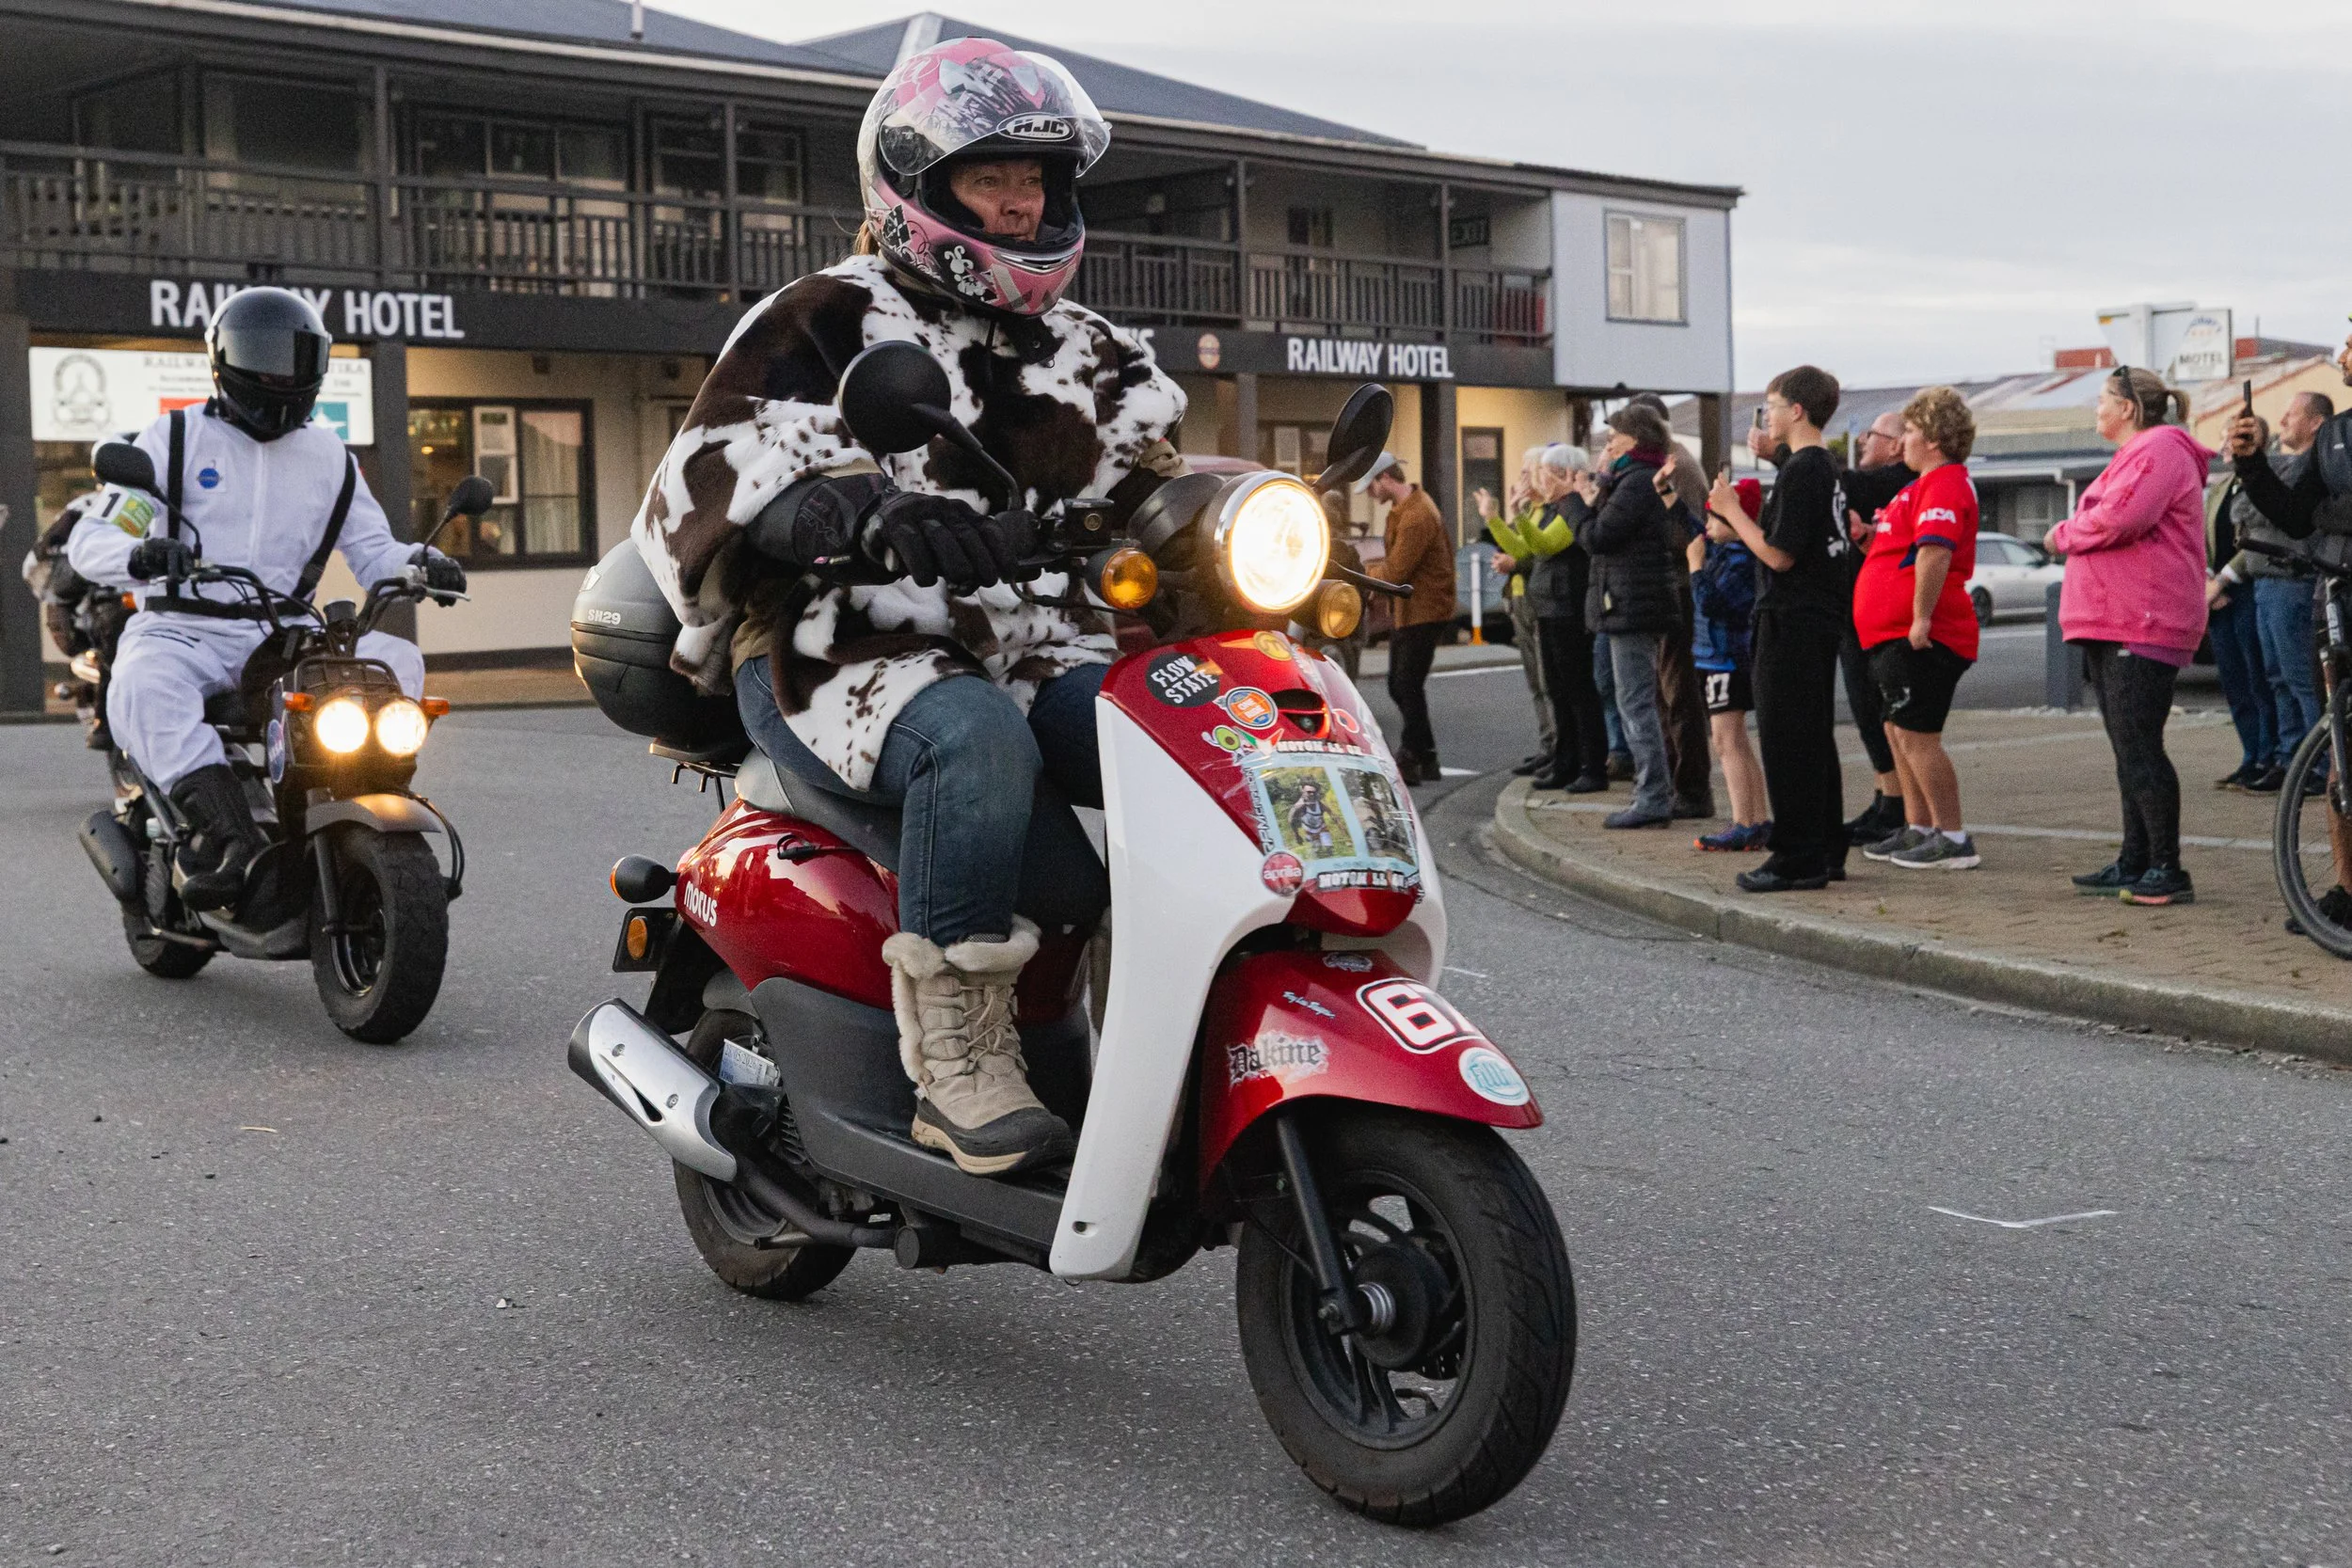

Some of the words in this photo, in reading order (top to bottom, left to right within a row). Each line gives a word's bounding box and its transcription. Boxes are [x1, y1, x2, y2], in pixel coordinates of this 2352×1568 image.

[1013, 119, 1064, 135] HJC
[151, 280, 332, 328] RAIY
[343, 290, 465, 339] HOTEL
[143, 356, 209, 369] RAILWA
[1288, 337, 1383, 374] RAILWAY
[1388, 343, 1454, 378] HOTEL
[2179, 353, 2223, 365] MOTEL
[102, 492, 121, 517] 1
[587, 609, 621, 626] SH29
[1151, 656, 1197, 688] FLOW
[1165, 669, 1218, 705] STATE
[1263, 864, 1302, 881] aprilia
[1228, 1037, 1320, 1079] Dakine
